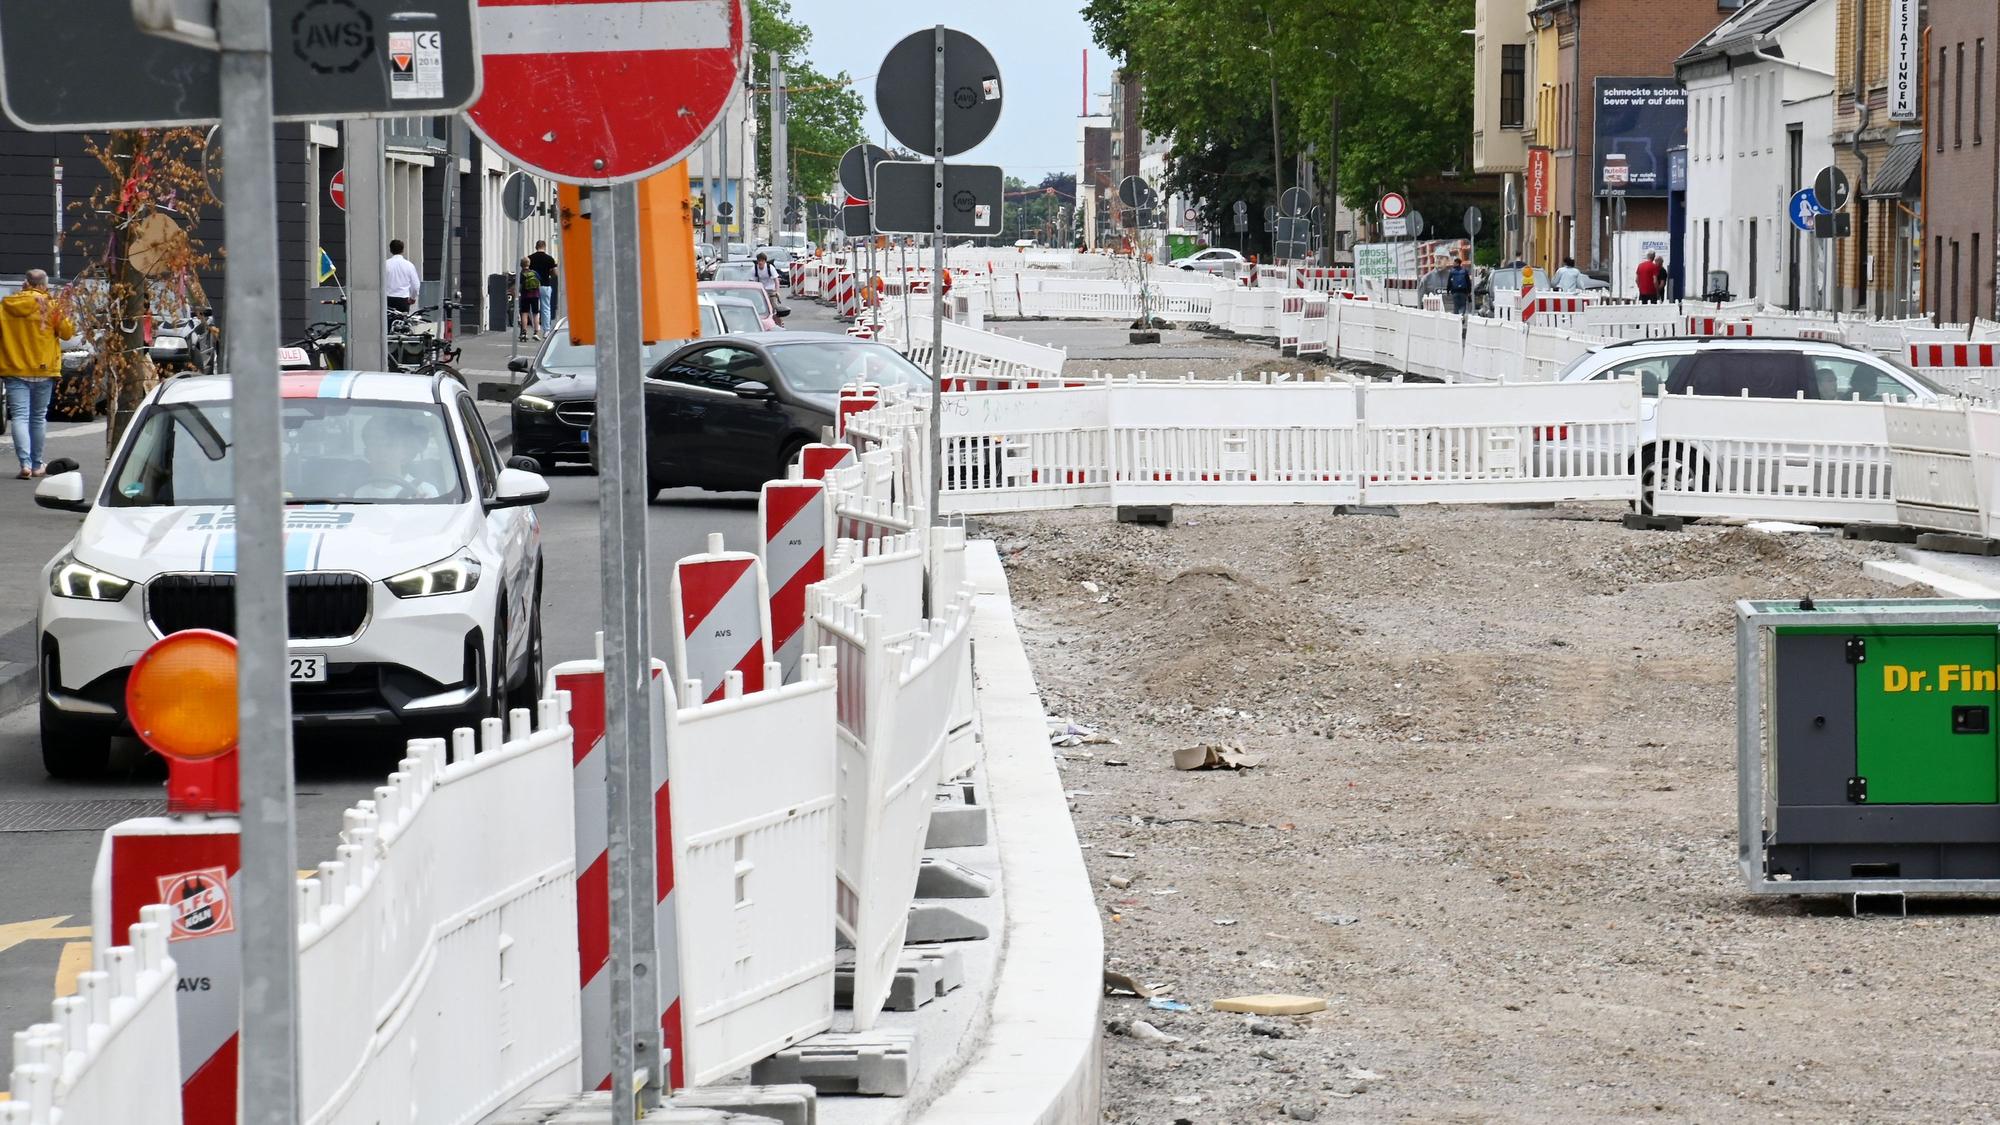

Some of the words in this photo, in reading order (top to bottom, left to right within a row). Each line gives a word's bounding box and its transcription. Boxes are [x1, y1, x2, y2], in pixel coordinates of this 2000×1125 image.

[306, 22, 363, 48] AVS
[418, 57, 440, 66] 2018
[1898, 0, 1908, 110] ESTATTUNGEN
[1603, 87, 1651, 96] schmeckte
[1653, 87, 1679, 96] schon
[1603, 97, 1629, 105] bevor
[1631, 97, 1645, 105] wir
[1647, 97, 1663, 105] auf
[1665, 97, 1684, 105] dem
[1534, 151, 1543, 213] THEATER
[715, 629, 732, 638] AVS
[290, 659, 316, 679] 23
[1884, 665, 1932, 692] Dr.
[1938, 664, 2000, 692] Fin
[176, 977, 211, 992] AVS
